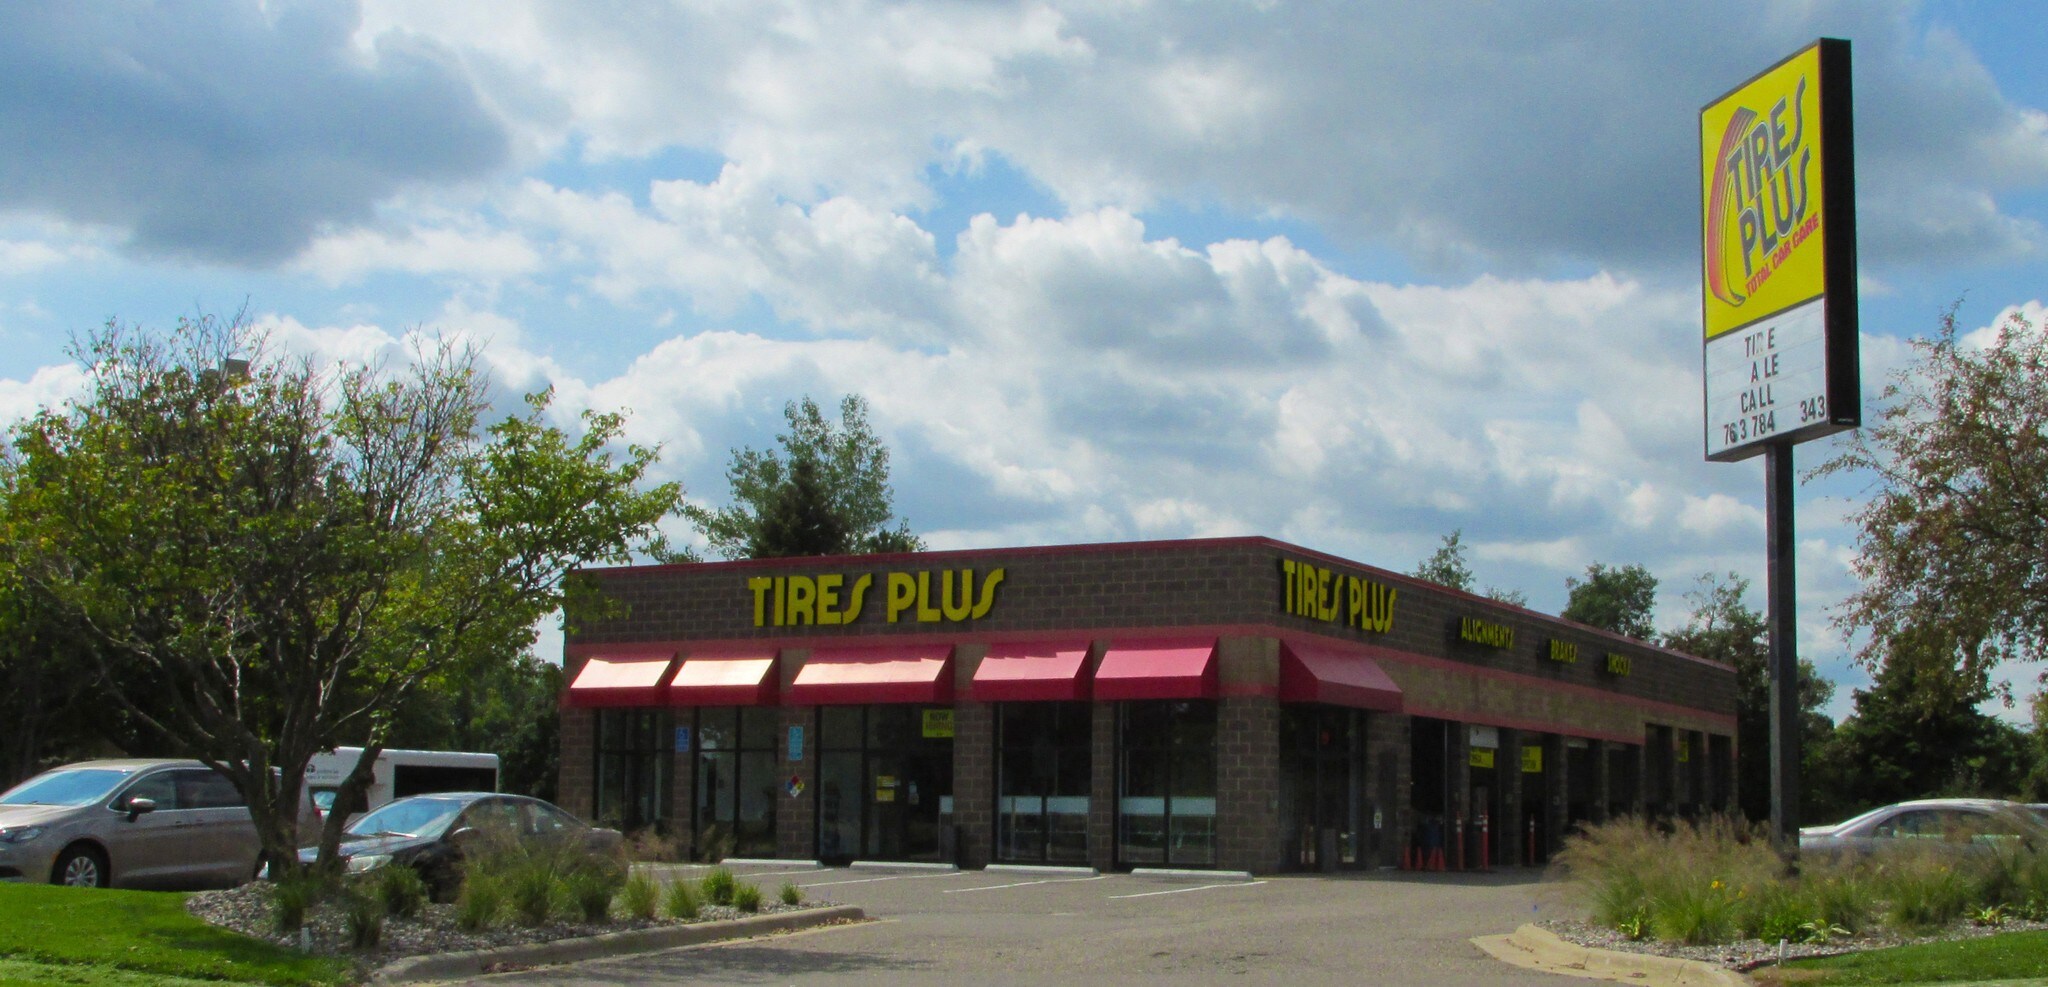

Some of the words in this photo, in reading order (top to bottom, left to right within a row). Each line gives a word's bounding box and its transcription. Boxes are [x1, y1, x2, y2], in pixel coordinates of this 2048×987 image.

[1726, 73, 1806, 214] TIRES
[1738, 144, 1811, 278] PLUS
[1745, 263, 1773, 298] TOTAL
[1772, 243, 1793, 271] CAR
[1792, 211, 1820, 252] CARE
[1724, 419, 1747, 445] 763
[1752, 410, 1775, 437] 784
[1800, 395, 1826, 423] 343
[1740, 384, 1775, 414] CALL
[748, 573, 872, 627] TIRES
[887, 568, 1005, 622] PLUS
[1283, 559, 1344, 623] TIRES
[1348, 576, 1397, 634] PLUS
